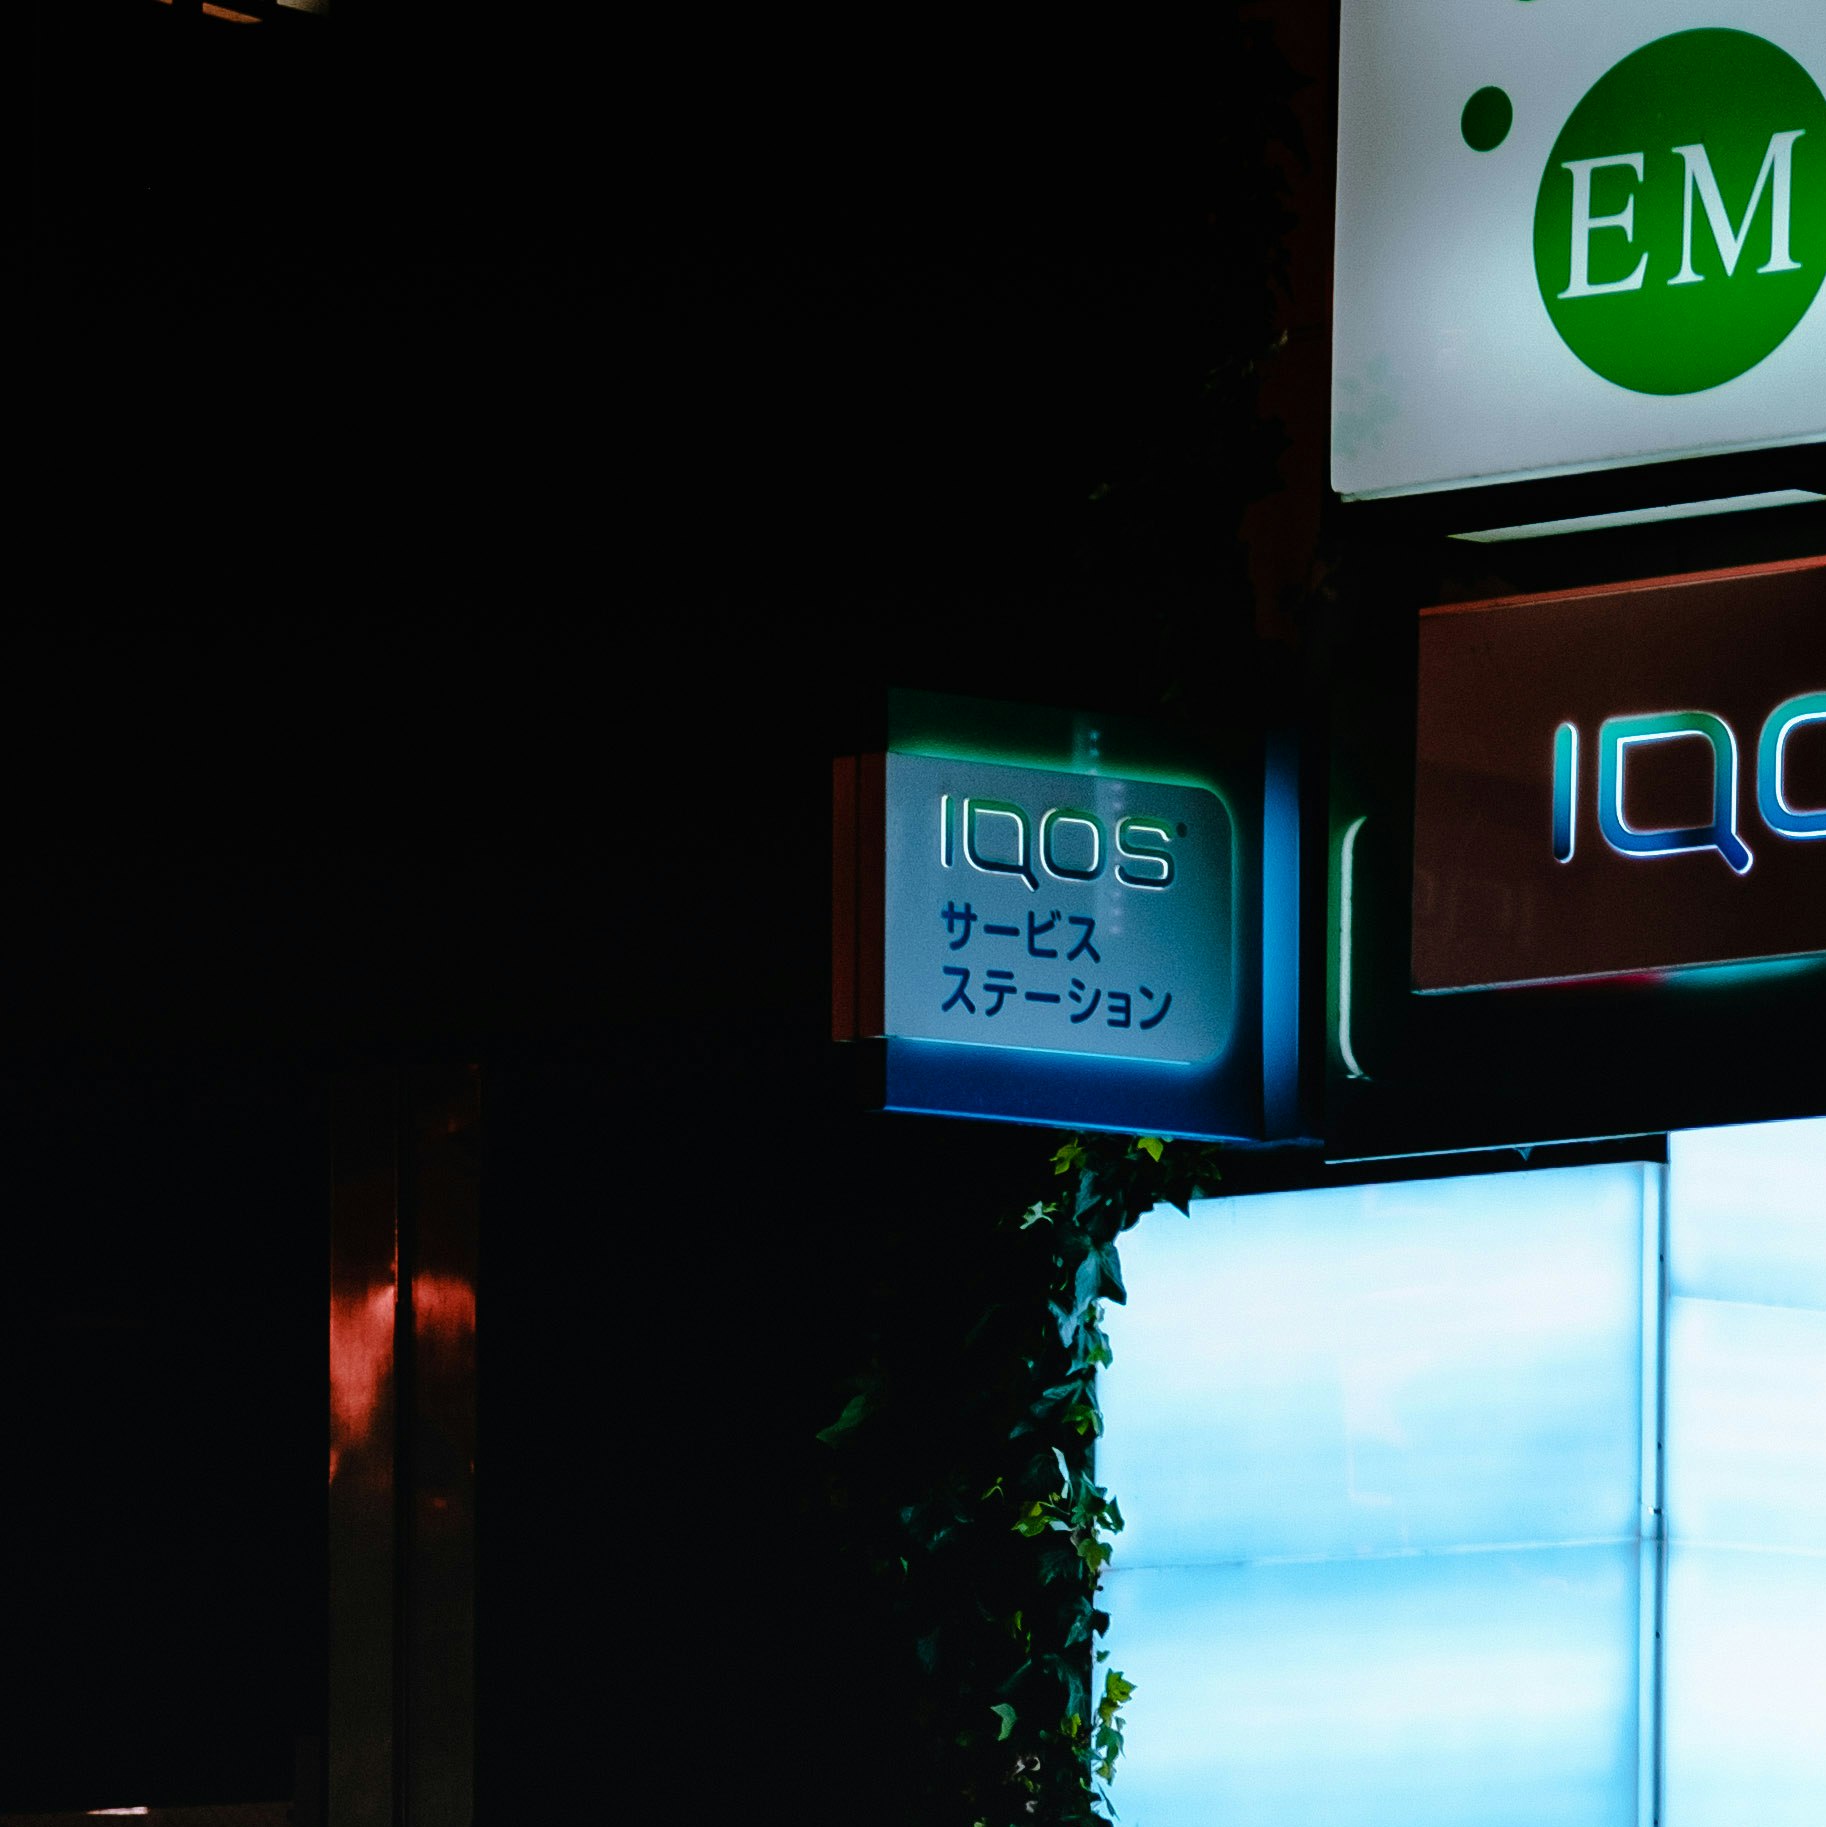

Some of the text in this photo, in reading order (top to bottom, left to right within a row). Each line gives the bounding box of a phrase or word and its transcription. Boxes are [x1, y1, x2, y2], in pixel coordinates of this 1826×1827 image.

[1558, 129, 1807, 300] EM
[939, 794, 1176, 892] IQOS
[940, 901, 1101, 964] サービス
[941, 965, 1173, 1030] ステーション
